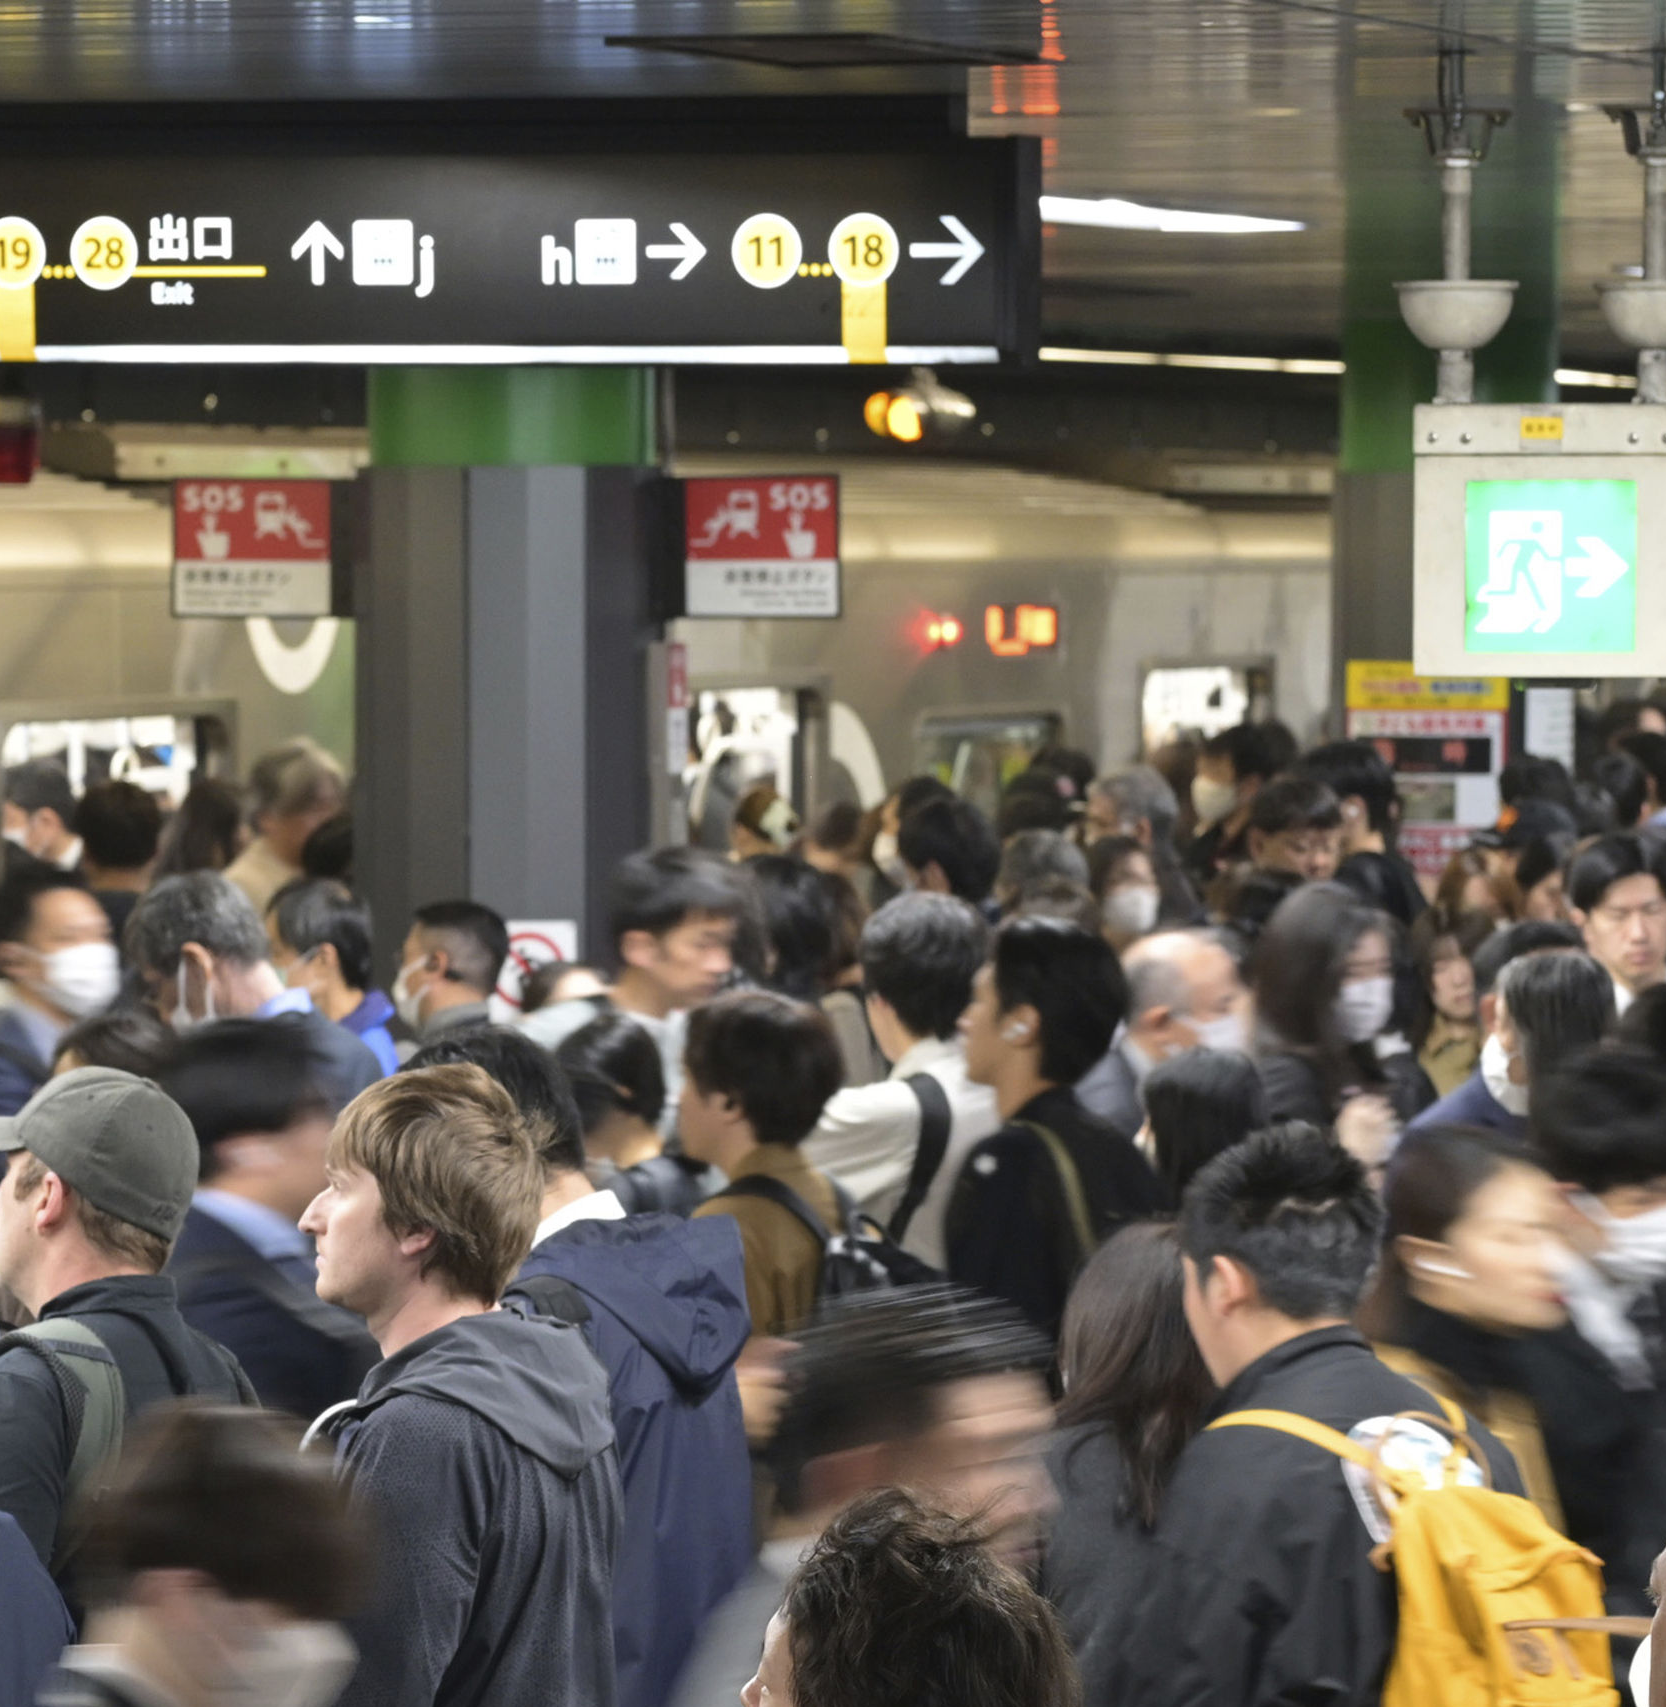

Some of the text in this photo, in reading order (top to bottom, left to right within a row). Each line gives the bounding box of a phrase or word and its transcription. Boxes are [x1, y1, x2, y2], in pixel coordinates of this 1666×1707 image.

[84, 237, 124, 270] 28
[149, 215, 232, 261] 出口
[748, 236, 785, 268] 11
[843, 234, 884, 267] 18
[150, 281, 194, 306] Exit
[183, 484, 245, 513] SOS
[769, 482, 831, 512] SOS
